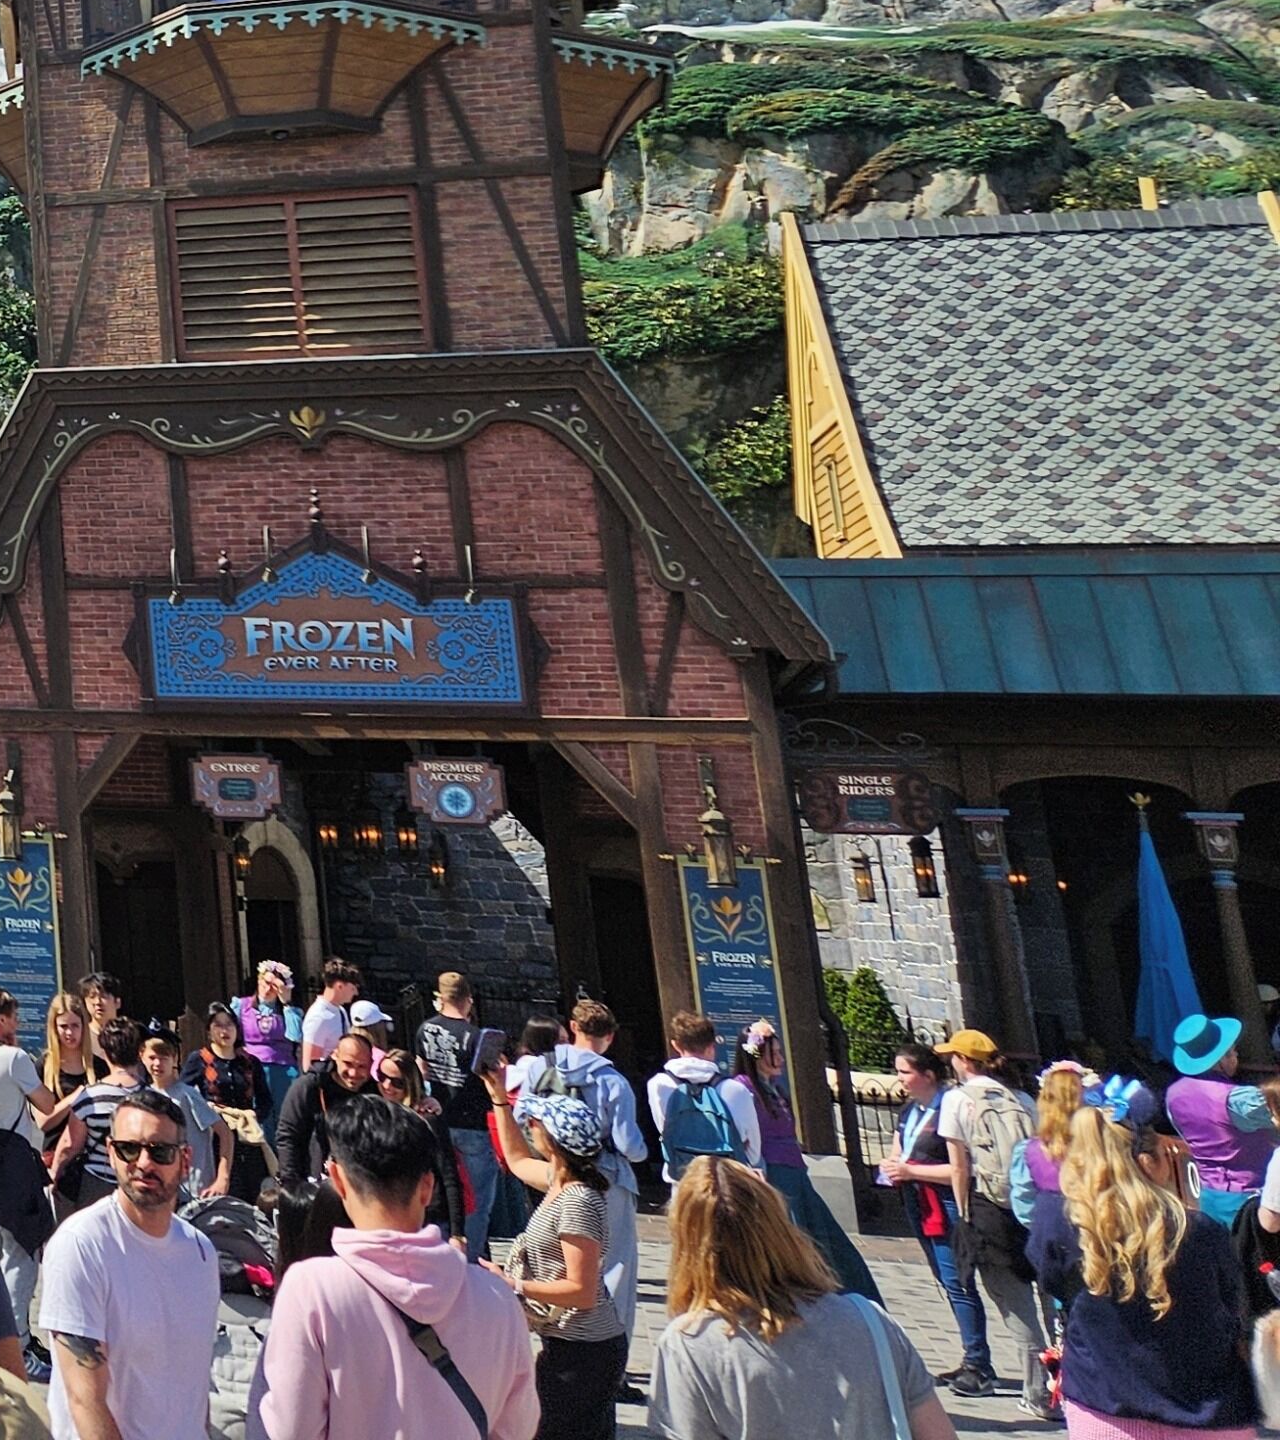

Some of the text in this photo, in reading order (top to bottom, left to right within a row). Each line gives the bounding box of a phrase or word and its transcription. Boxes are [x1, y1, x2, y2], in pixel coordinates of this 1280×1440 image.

[241, 617, 416, 660] FROZEN
[264, 656, 399, 673] EVER AFTER
[423, 762, 484, 773] PREMIER
[430, 772, 481, 783] ACCESS
[838, 775, 892, 785] SINGLE
[838, 785, 896, 796] RIDERS
[4, 917, 41, 930] FROZEN
[711, 950, 757, 965] FROZEN
